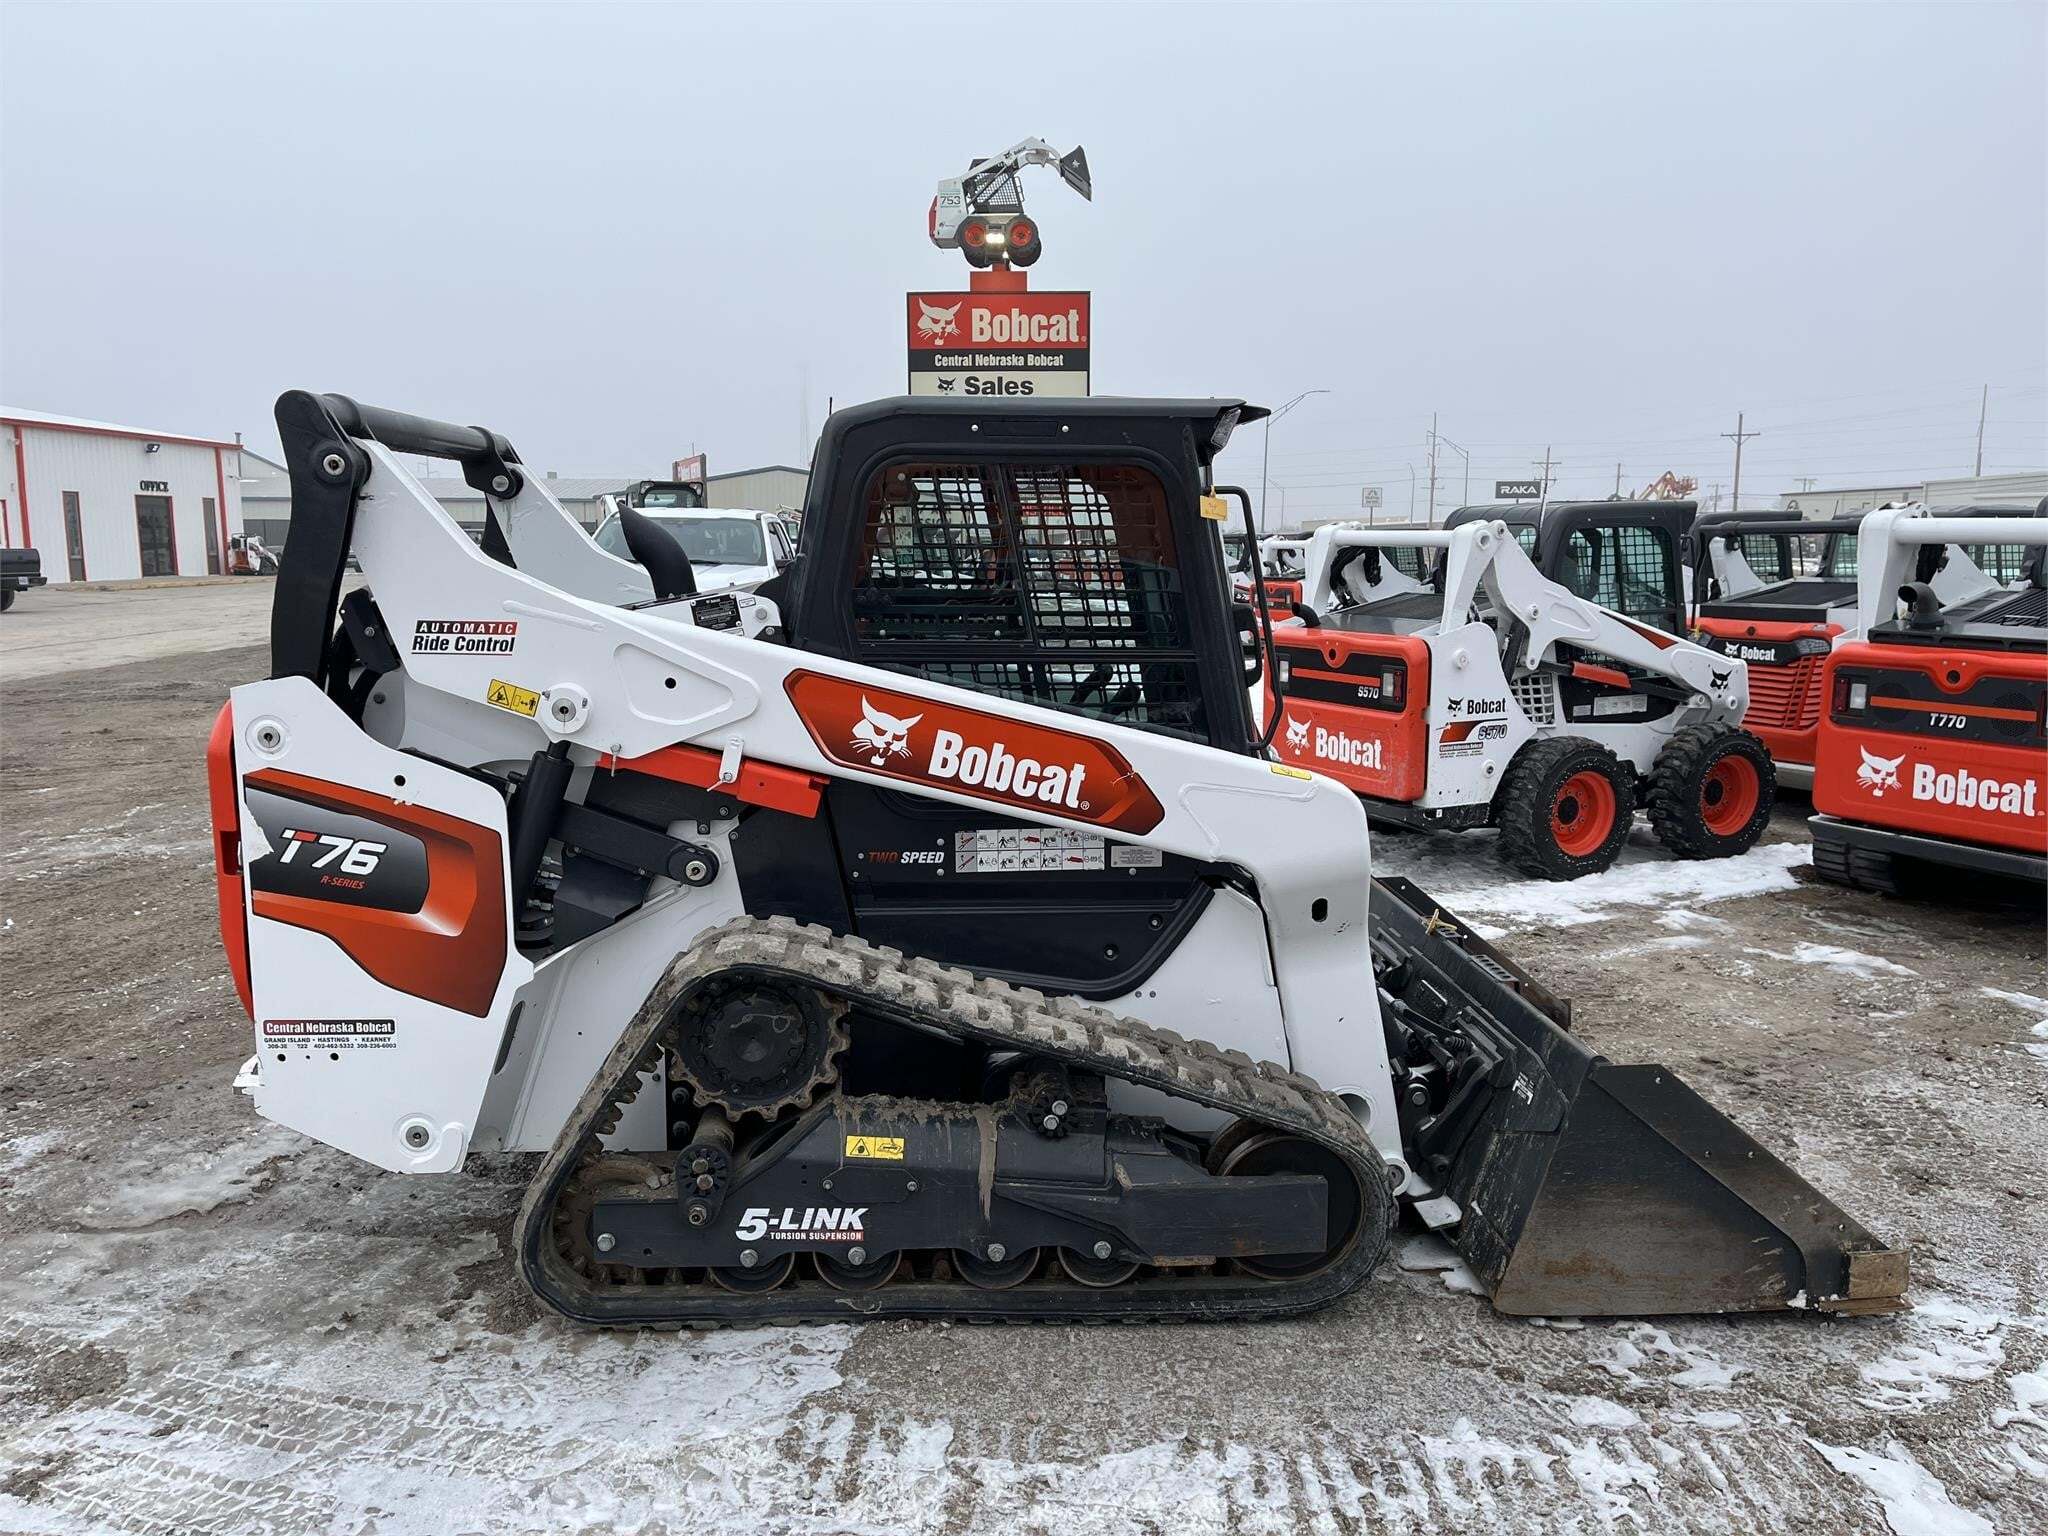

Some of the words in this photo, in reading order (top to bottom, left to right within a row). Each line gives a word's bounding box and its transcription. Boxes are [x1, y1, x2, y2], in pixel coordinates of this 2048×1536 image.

[940, 195, 961, 206] 753
[971, 307, 1080, 343] Bobcat
[934, 354, 972, 367] Central
[975, 354, 1025, 366] Nebraska
[1027, 354, 1064, 366] Bobcat
[964, 375, 1034, 396] Sales
[140, 480, 169, 492] OFFICE
[1500, 486, 1537, 494] RAKA
[419, 622, 514, 634] AUTOMATIC
[412, 635, 450, 651] Ride
[454, 635, 515, 652] Control
[1740, 646, 1775, 661] Bobcat
[1358, 686, 1380, 699] S570
[1467, 697, 1506, 715] Bobcat
[1929, 712, 1967, 729] T770
[1478, 724, 1508, 740] S570
[1315, 727, 1383, 771] Bobcat
[927, 728, 1087, 809] Bobcat
[1912, 763, 2038, 817] Bobcat
[279, 829, 387, 876] T76
[868, 851, 898, 863] TWO
[900, 851, 945, 864] SPEED
[320, 874, 366, 890] R-SERIES
[266, 1022, 304, 1033] Central
[306, 1022, 354, 1033] Nebraska
[356, 1022, 392, 1033] Bobcat
[735, 1207, 869, 1241] 5-LINK
[770, 1231, 807, 1241] TORSION
[809, 1231, 862, 1241] SUSPENSION
